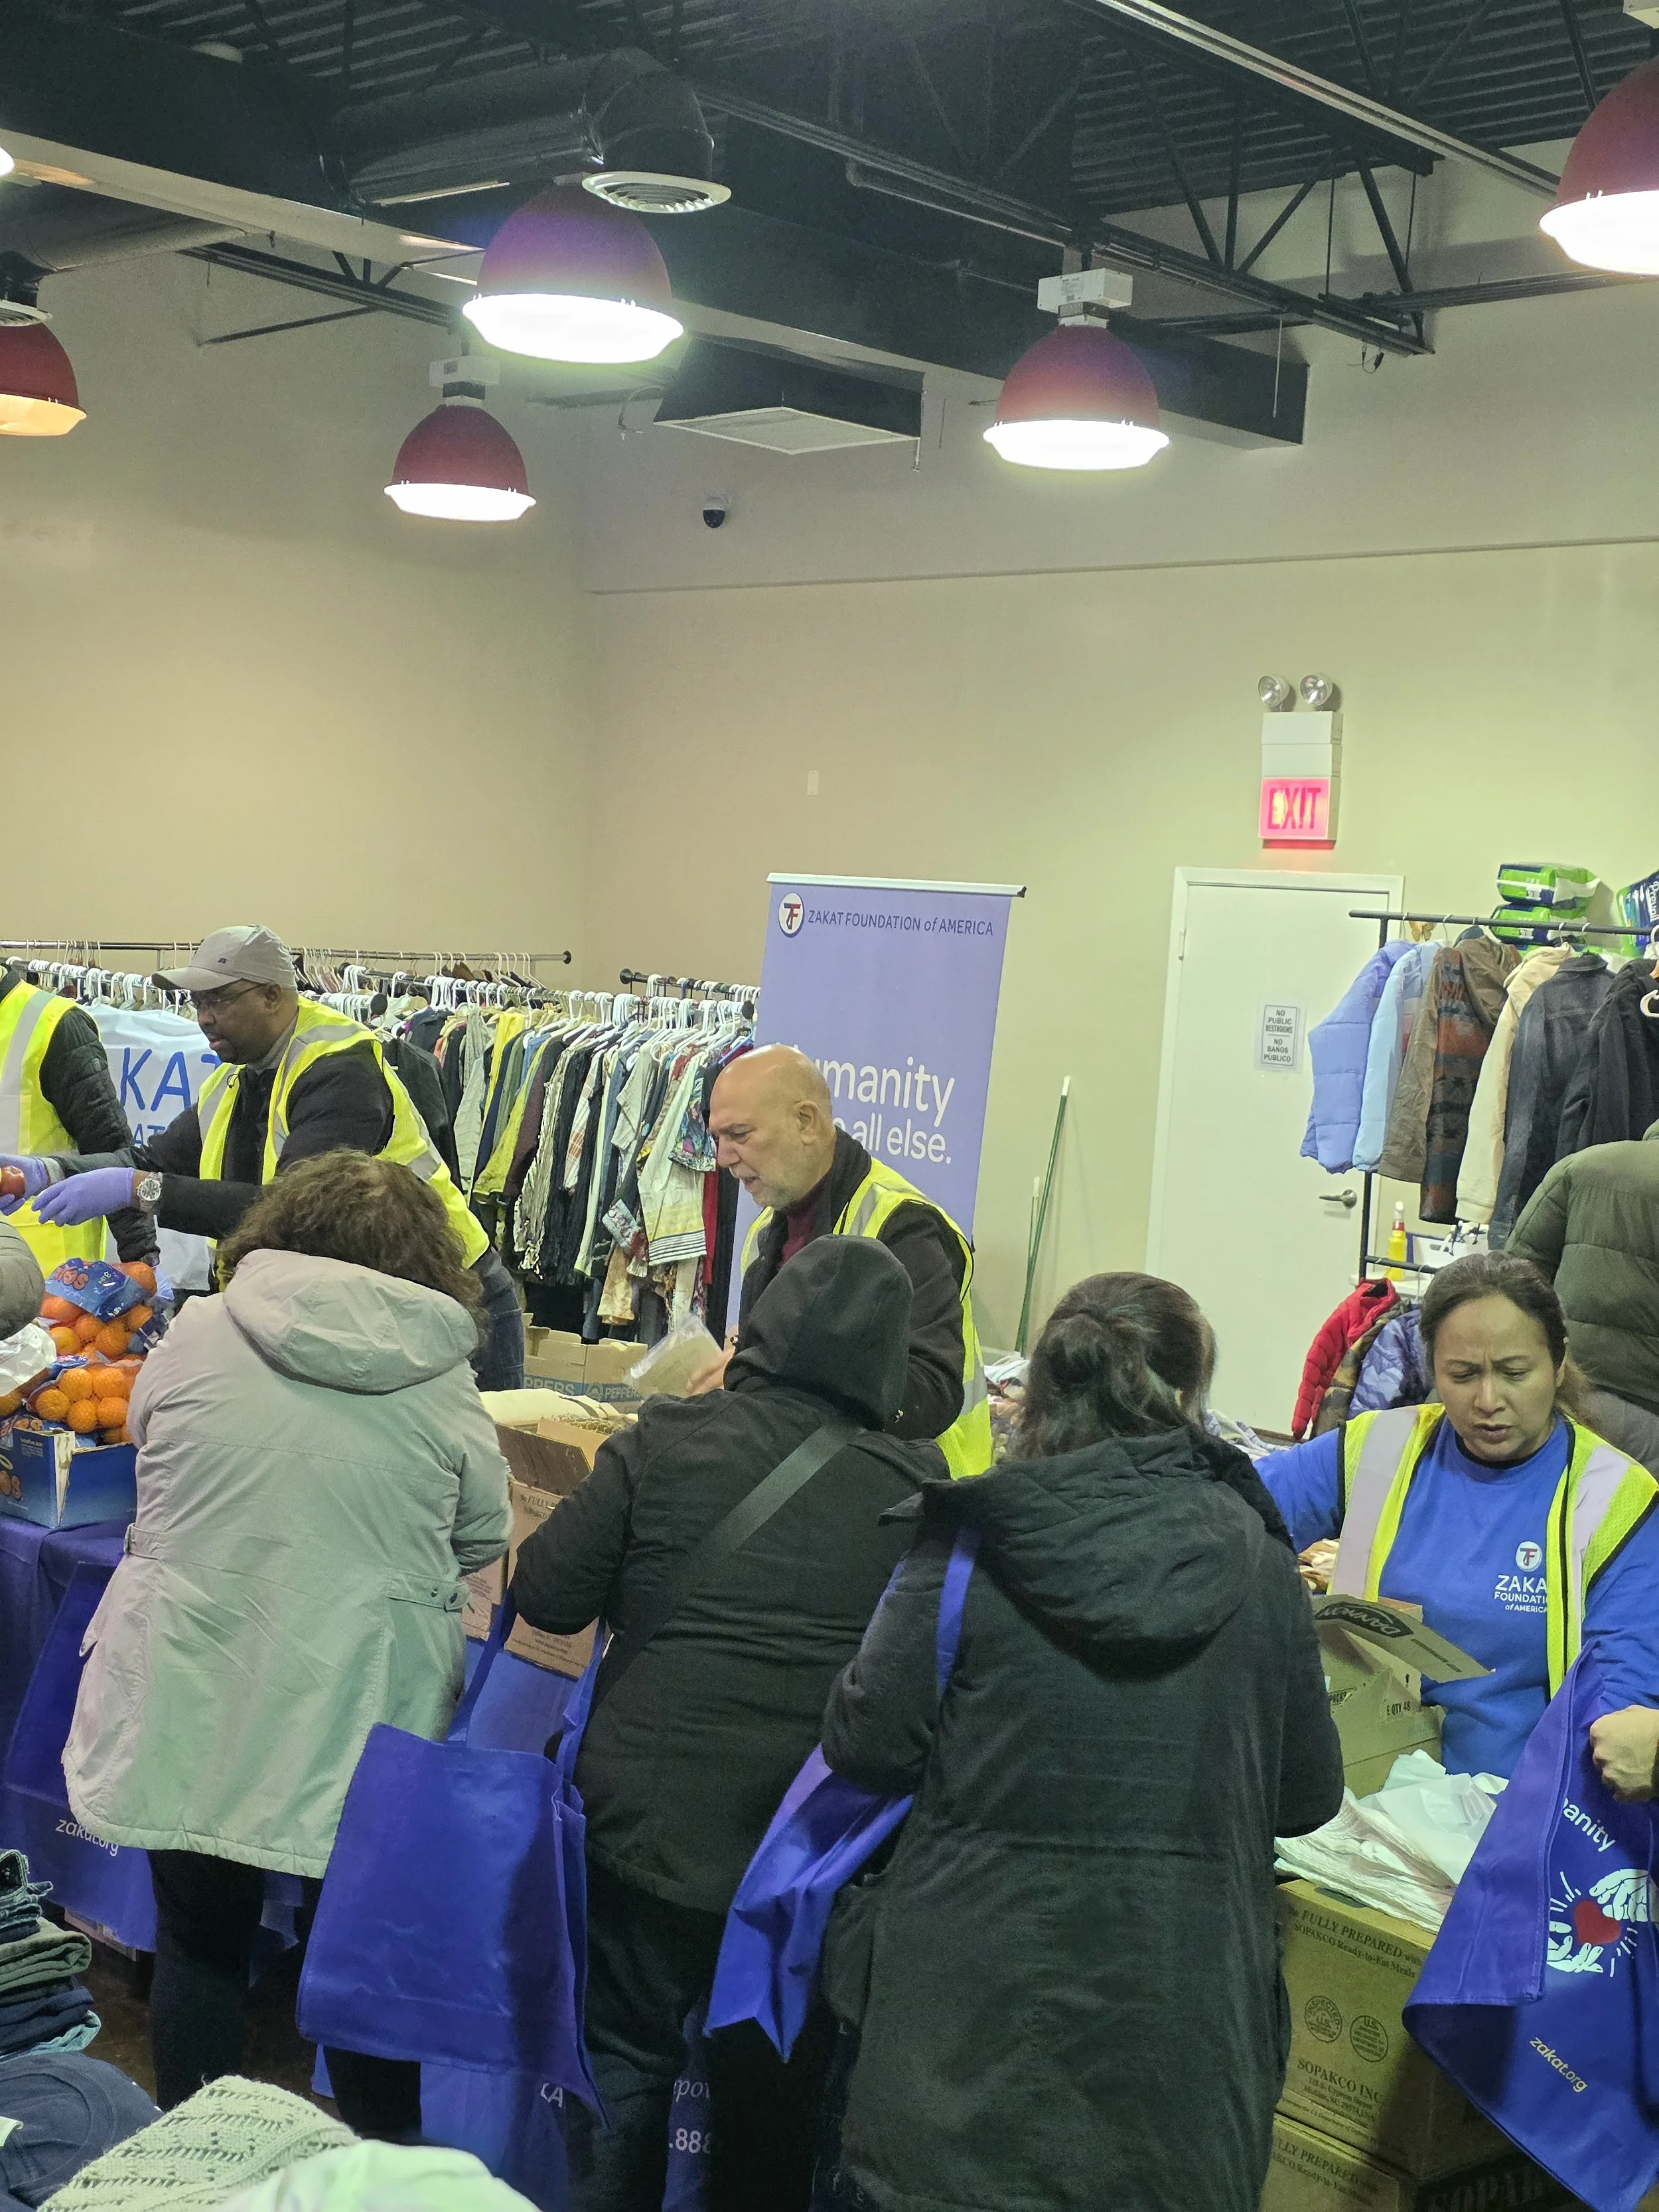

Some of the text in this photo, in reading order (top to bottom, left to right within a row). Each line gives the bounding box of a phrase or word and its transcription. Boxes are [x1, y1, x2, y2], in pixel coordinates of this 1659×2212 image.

[1267, 787, 1321, 830] EXIT
[808, 910, 993, 936] ZAKAT FOUNDATION of AMERICA
[816, 1056, 956, 1128] manity
[851, 1112, 952, 1164] all else.
[1494, 1591, 1548, 1604] FOUNDATI
[1495, 1574, 1547, 1593] ZAKA
[1563, 1797, 1616, 1852] anity
[1301, 1909, 1340, 1934] FULLY
[1341, 1925, 1403, 1958] PREPARED
[1297, 2058, 1357, 2093] SOPAKCO
[1530, 2037, 1588, 2093] zakat.org
